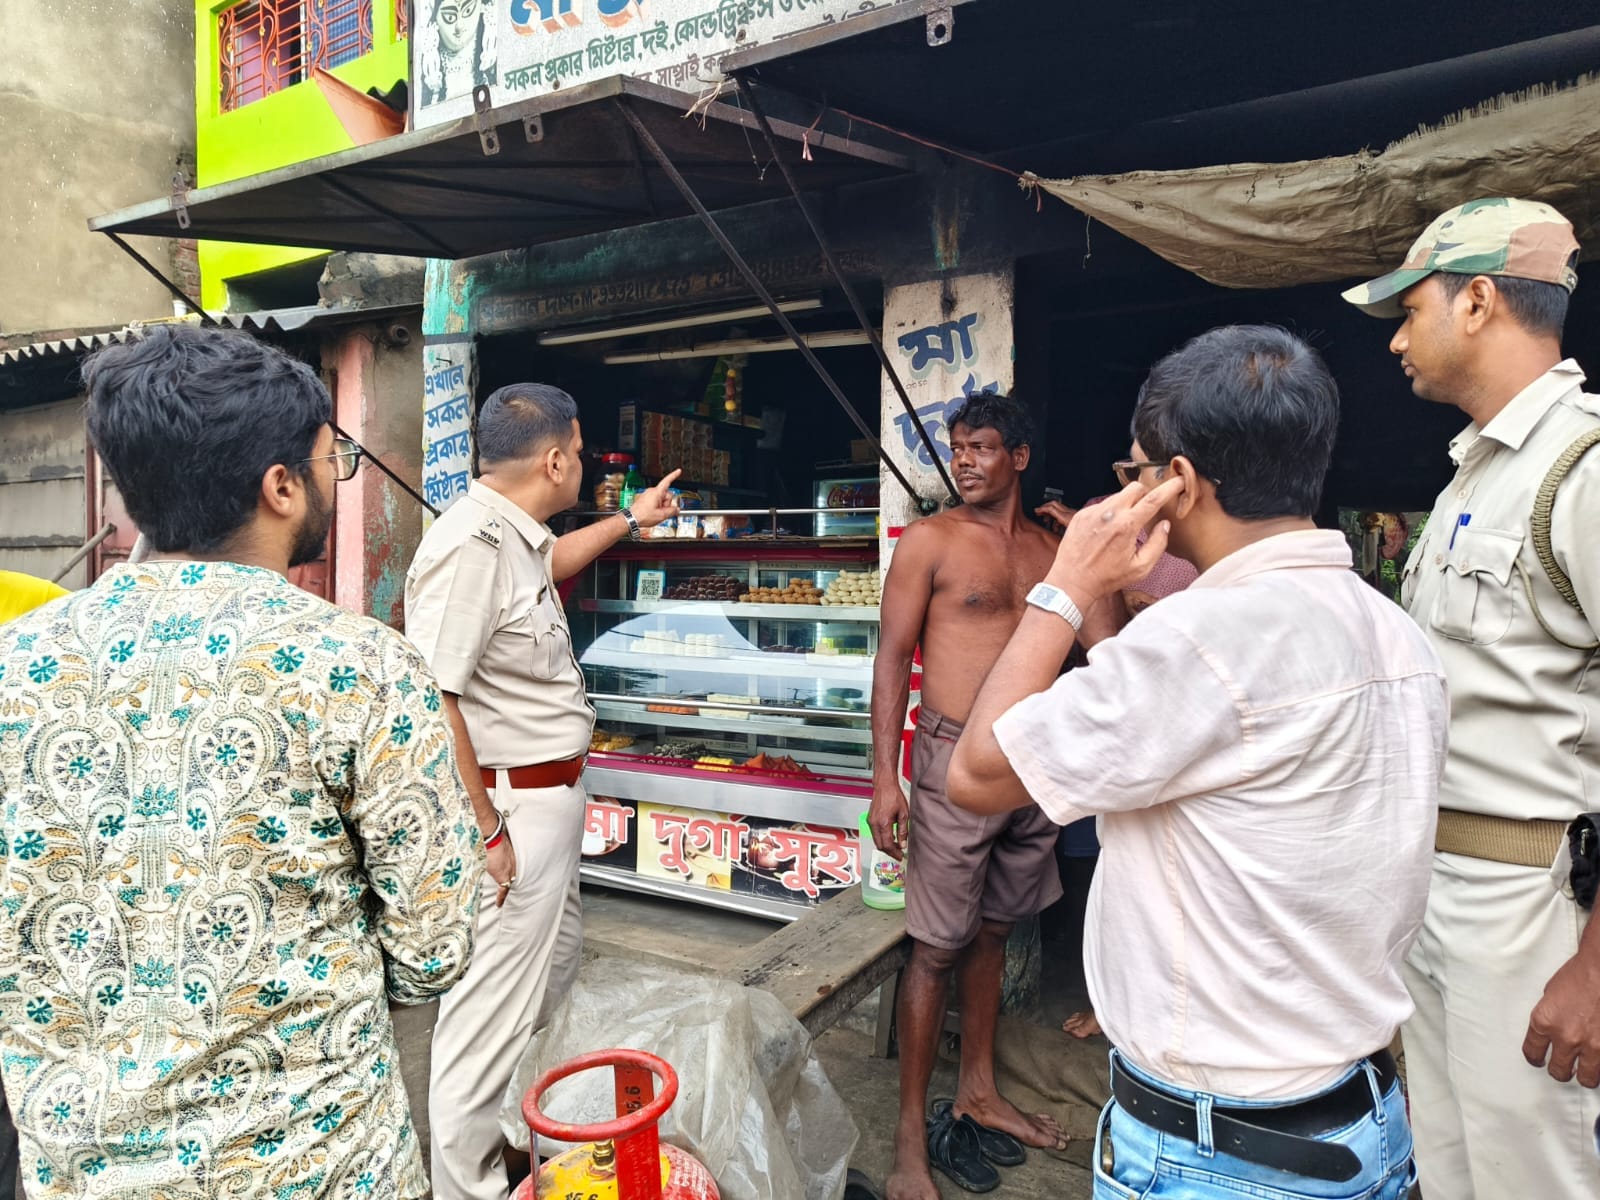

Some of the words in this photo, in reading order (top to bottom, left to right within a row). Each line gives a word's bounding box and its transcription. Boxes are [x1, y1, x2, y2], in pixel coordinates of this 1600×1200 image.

[503, 62, 545, 91] সকল
[544, 49, 584, 82] প্রকার
[897, 311, 981, 377] মা
[425, 363, 465, 396] এখানে
[424, 392, 470, 429] সকল
[425, 429, 471, 467] প্রকার
[585, 801, 635, 843] মা
[768, 824, 862, 898] সুই
